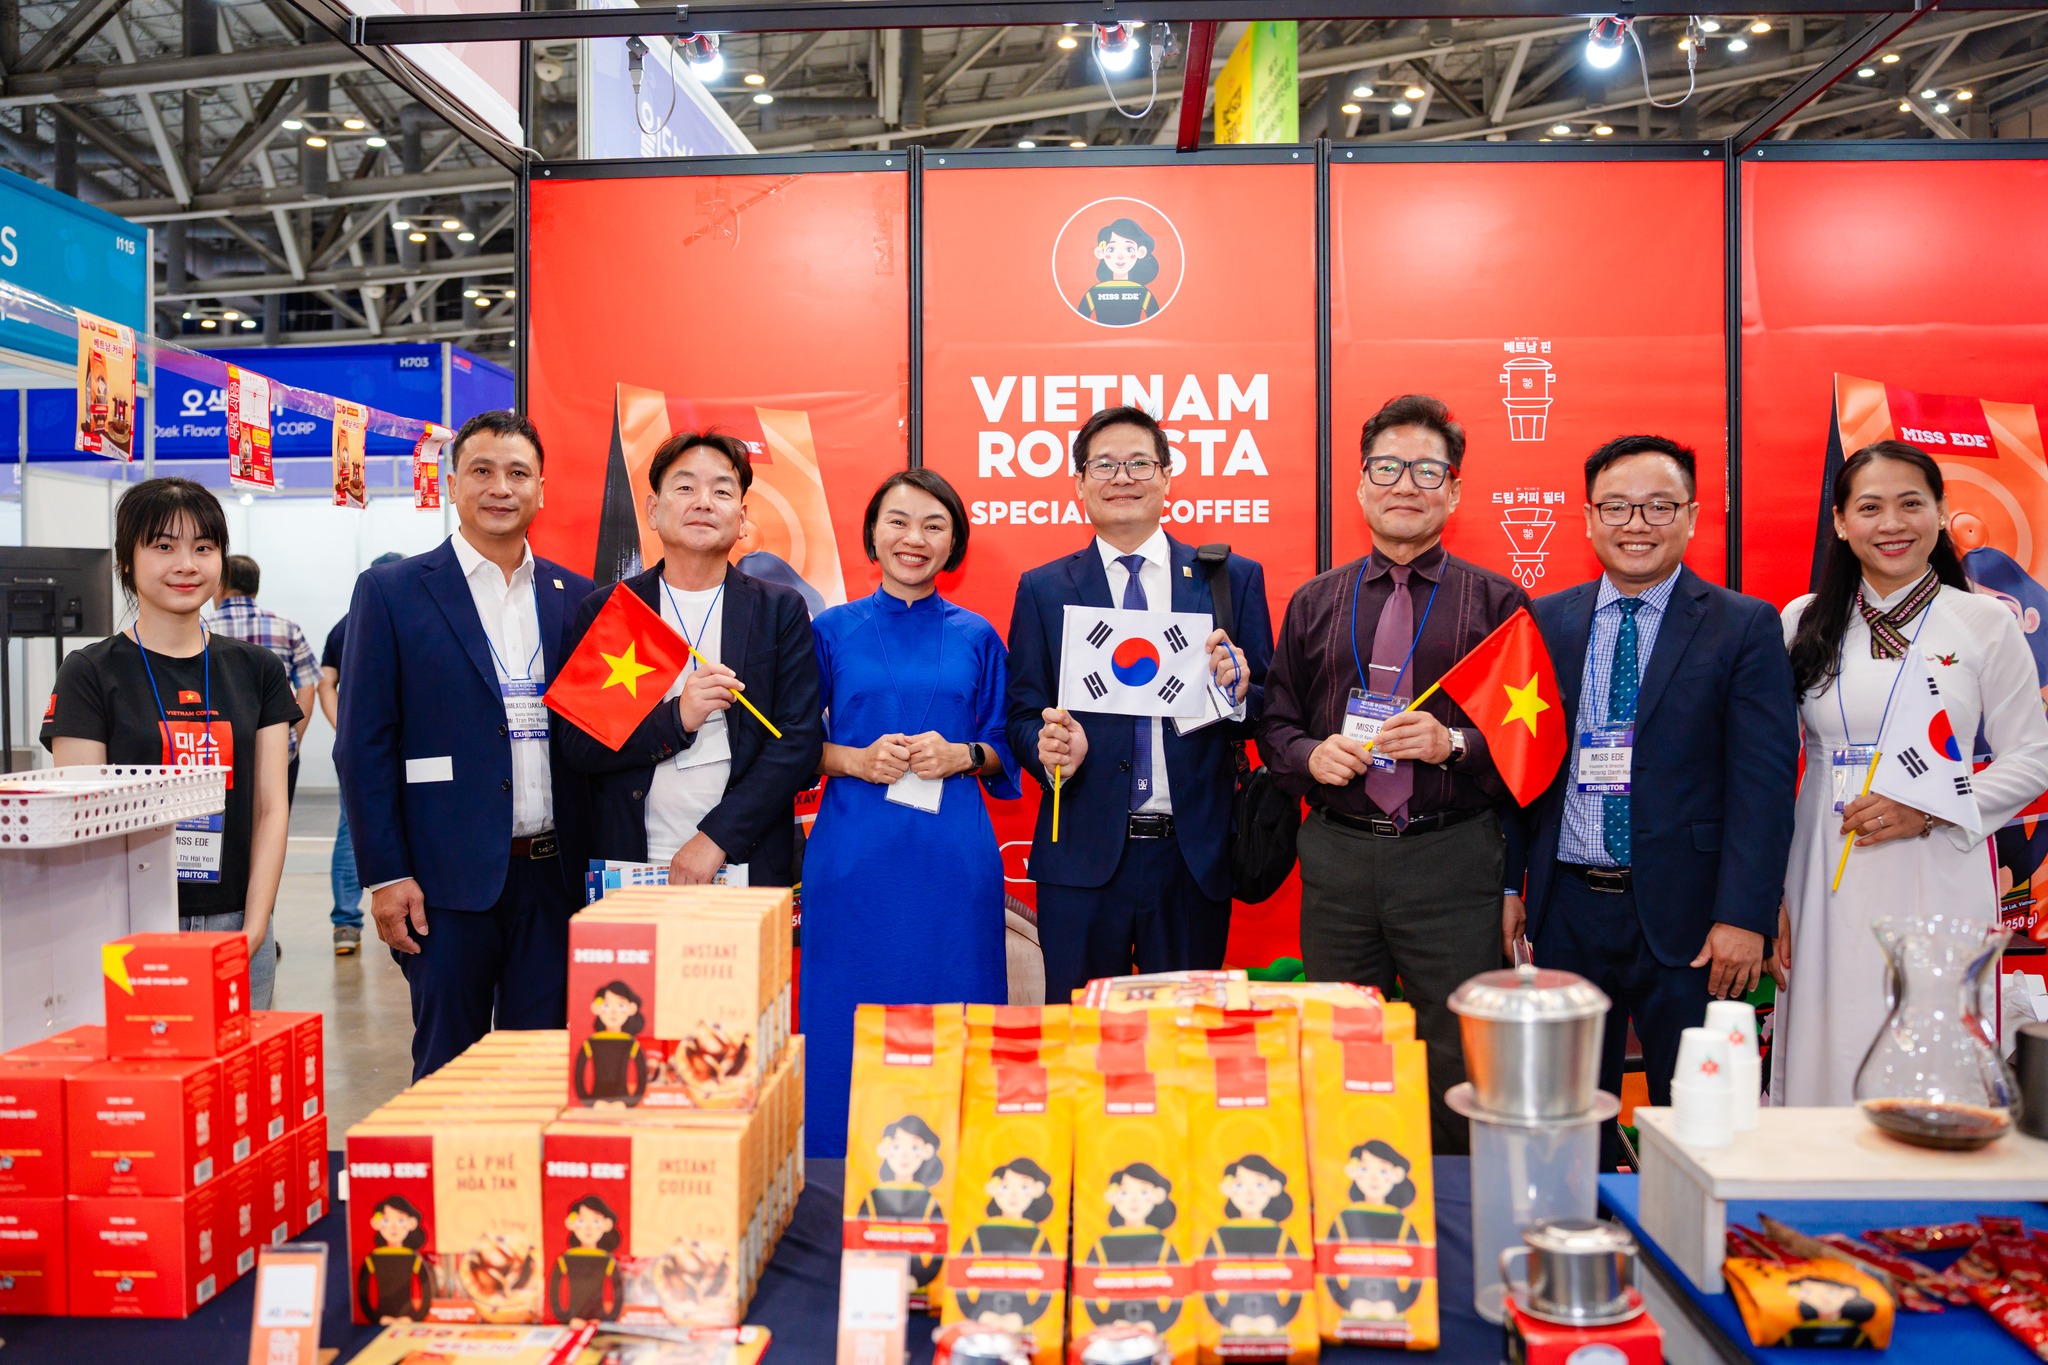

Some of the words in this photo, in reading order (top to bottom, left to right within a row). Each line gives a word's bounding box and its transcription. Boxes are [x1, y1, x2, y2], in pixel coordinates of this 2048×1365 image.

[1098, 293, 1120, 301] MISS
[93, 338, 111, 353] 베트남
[112, 344, 124, 357] 커피
[1503, 341, 1537, 354] 베트남
[1540, 341, 1551, 353] 핀
[400, 357, 429, 368] H703
[970, 373, 1269, 423] VIETNAM
[182, 423, 222, 437] Flavor
[277, 422, 316, 435] CORP
[1901, 427, 1947, 445] MISS
[978, 429, 1269, 478] ROSTA
[1491, 491, 1514, 505] 드립
[1517, 491, 1540, 505] 커피
[1543, 491, 1565, 505] 필터
[1159, 500, 1269, 523] COFFEE
[513, 730, 546, 738] EXHIBITOR
[1356, 722, 1374, 733] MISS
[174, 732, 219, 752] 미스
[1591, 753, 1608, 761] MISS
[195, 837, 209, 846] EDE
[574, 948, 614, 963] MISS
[682, 944, 737, 959] INSTANT
[682, 964, 734, 979] COFFEE
[456, 1153, 478, 1171] CÀ
[485, 1152, 515, 1172] PHÊ
[547, 1161, 588, 1177] MISS
[658, 1159, 717, 1174] INSTANT
[350, 1162, 392, 1178] MISS
[457, 1176, 485, 1191] HÒA
[492, 1176, 517, 1190] TAN
[658, 1180, 712, 1195] COFFEE
